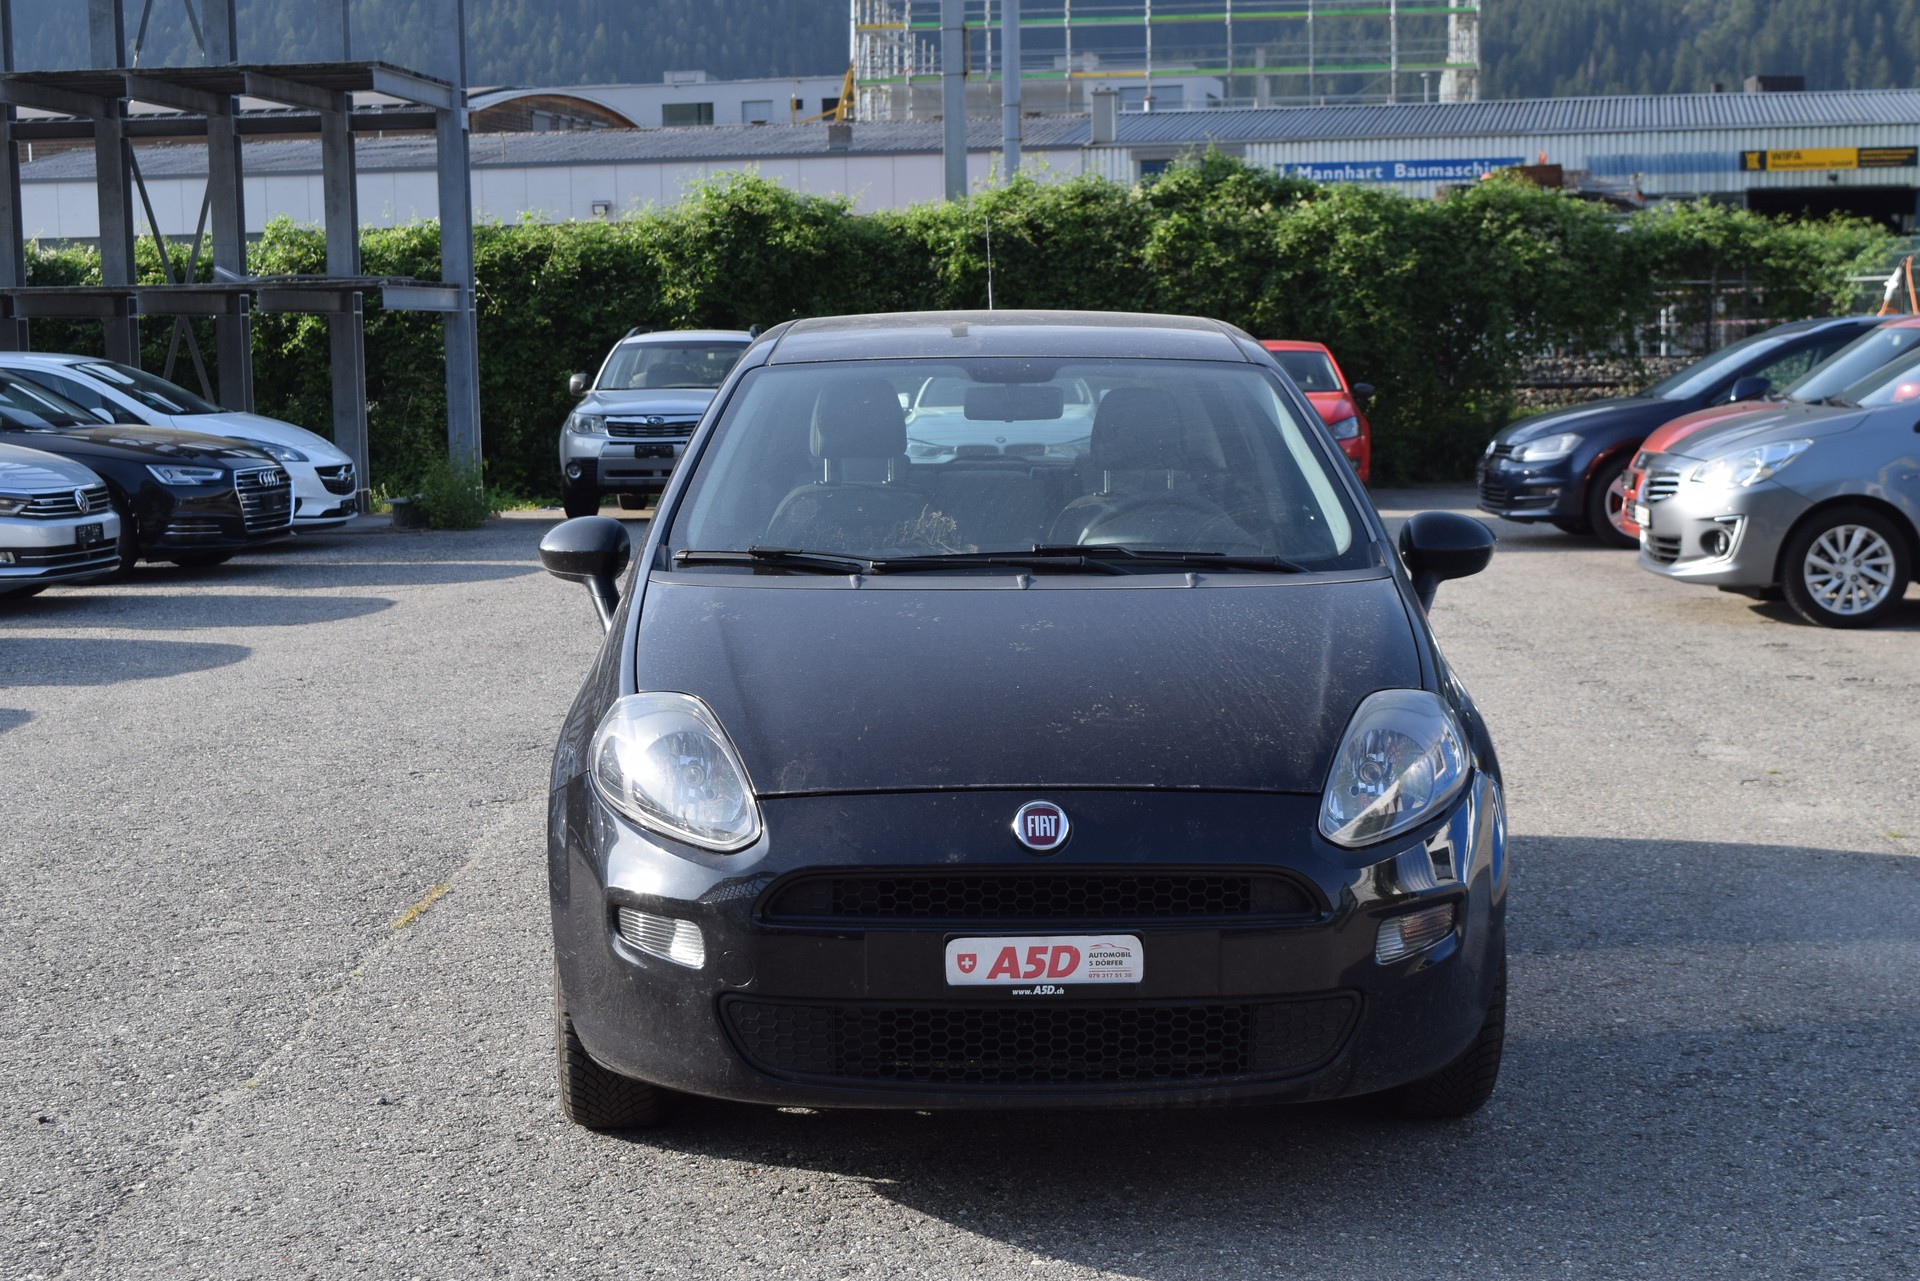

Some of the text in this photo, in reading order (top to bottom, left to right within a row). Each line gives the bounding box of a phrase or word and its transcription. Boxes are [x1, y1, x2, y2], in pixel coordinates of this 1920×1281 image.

[1297, 164, 1383, 181] Mannhart
[1027, 815, 1058, 837] FIAT
[986, 945, 1081, 979] A5D
[1012, 985, 1065, 995] www.A5D.ch
